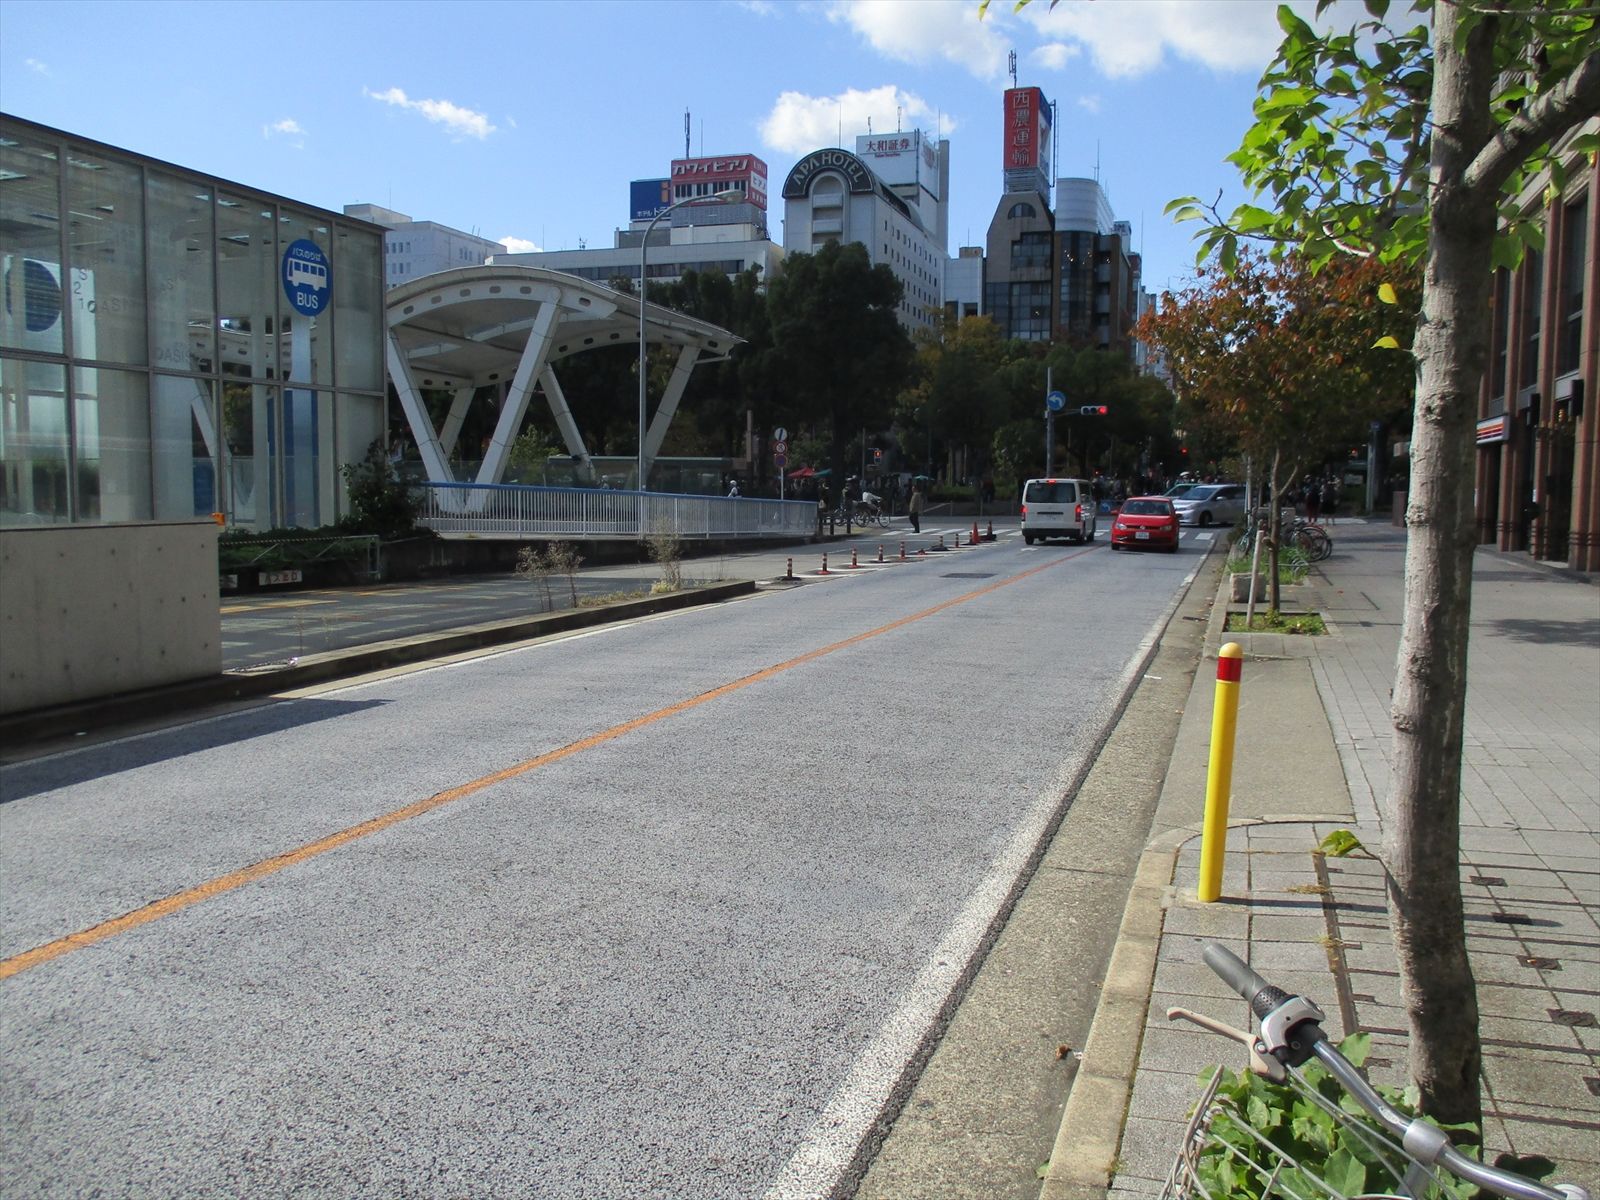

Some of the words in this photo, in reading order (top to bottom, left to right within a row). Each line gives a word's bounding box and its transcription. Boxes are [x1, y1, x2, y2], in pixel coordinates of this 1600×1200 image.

[1012, 90, 1030, 165] 西濃運輸
[865, 138, 909, 153] 大和証券
[792, 157, 820, 186] APA
[821, 151, 864, 183] HOTEL
[297, 291, 319, 309] BUS
